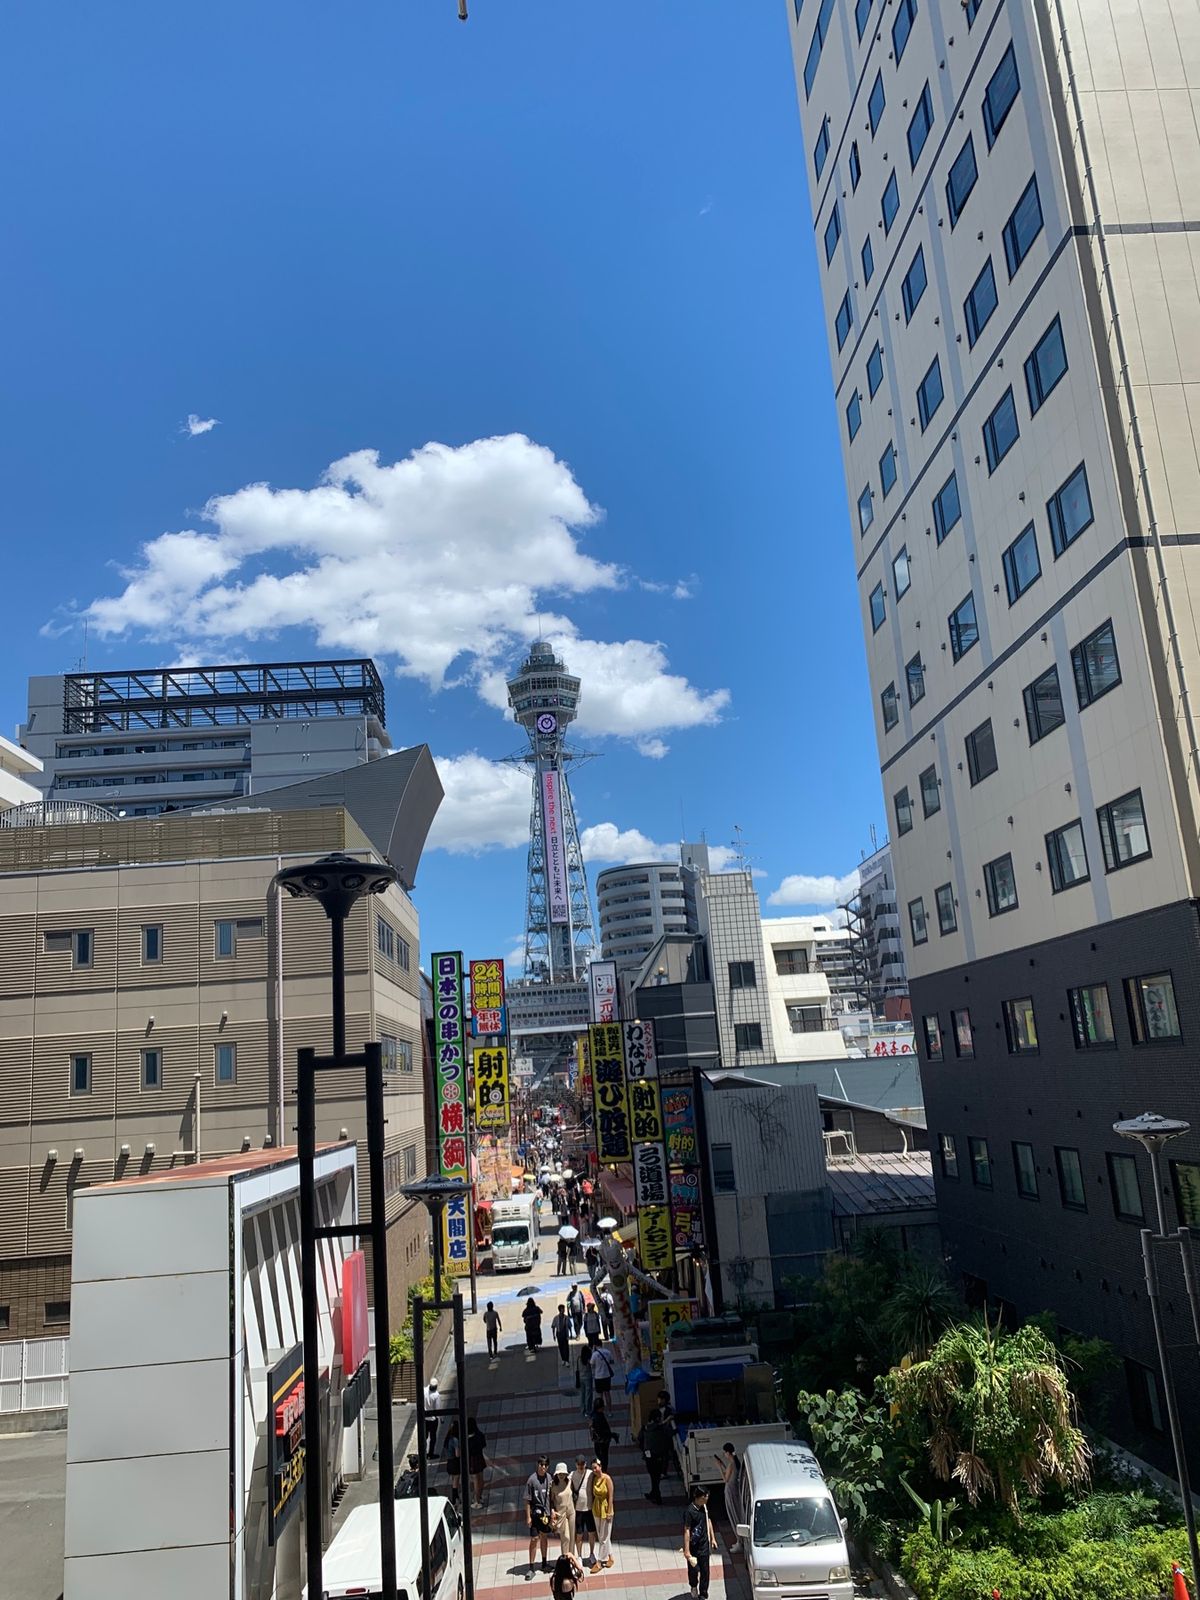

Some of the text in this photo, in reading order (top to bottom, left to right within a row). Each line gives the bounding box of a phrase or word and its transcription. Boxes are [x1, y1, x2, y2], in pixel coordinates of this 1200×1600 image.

[546, 774, 554, 799] Inspire
[551, 836, 562, 900] 日立とともに未来へ
[474, 963, 500, 981] 24
[474, 981, 501, 995] 時間
[474, 995, 502, 1009] 営業
[478, 1011, 500, 1022] 年中
[478, 1021, 502, 1033] 無休
[626, 1024, 647, 1077] わなげ
[643, 1023, 653, 1060] スペシャル
[874, 1040, 912, 1057] 餃子の
[439, 957, 467, 1169] 日本一の串かつ 横綱
[477, 1051, 505, 1108] 射的
[595, 1058, 629, 1158] 遊び放題
[632, 1085, 659, 1137] 射的
[668, 1134, 695, 1151] 射的
[638, 1146, 664, 1201] 弓道場
